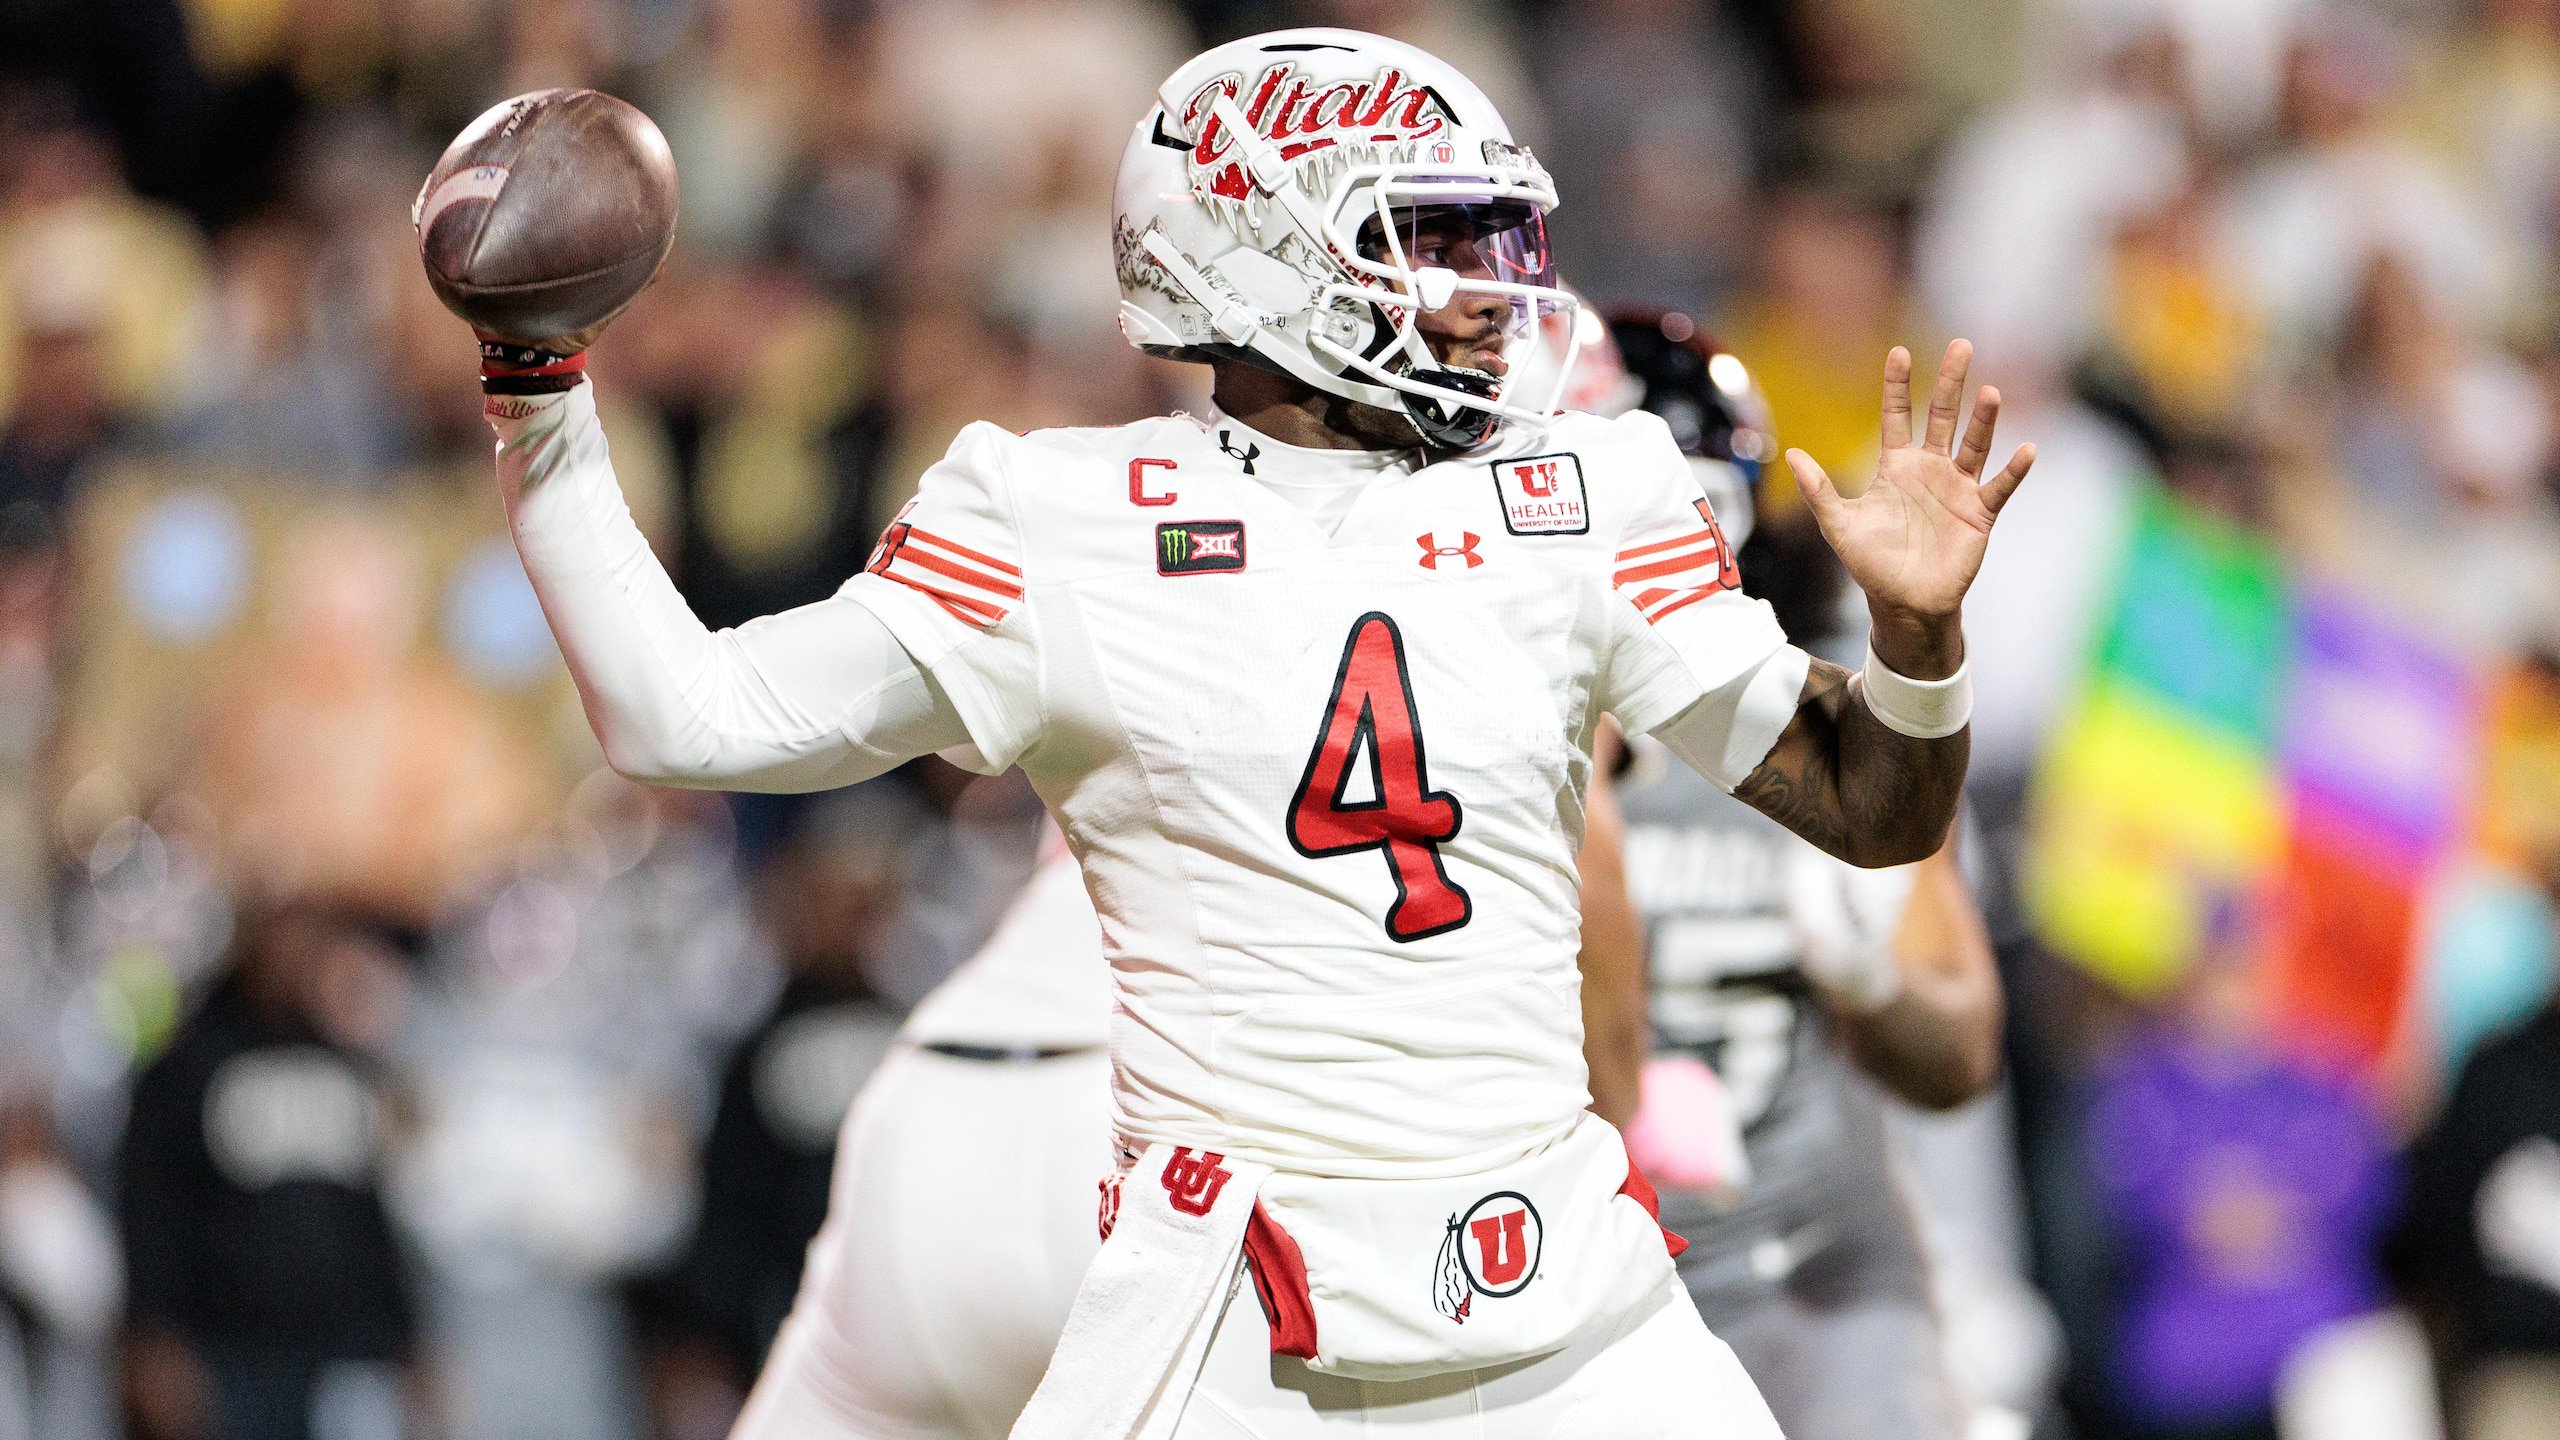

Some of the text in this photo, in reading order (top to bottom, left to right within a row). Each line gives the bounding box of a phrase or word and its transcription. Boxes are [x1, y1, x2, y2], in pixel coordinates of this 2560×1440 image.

[1181, 62, 1447, 167] Utah
[1437, 147, 1450, 163] U
[1129, 458, 1177, 507] C
[1511, 502, 1580, 519] HEALTH
[1513, 519, 1552, 528] UNIVERSITY
[1190, 532, 1239, 559] XII
[1286, 611, 1472, 944] 4
[1470, 1208, 1527, 1286] U
